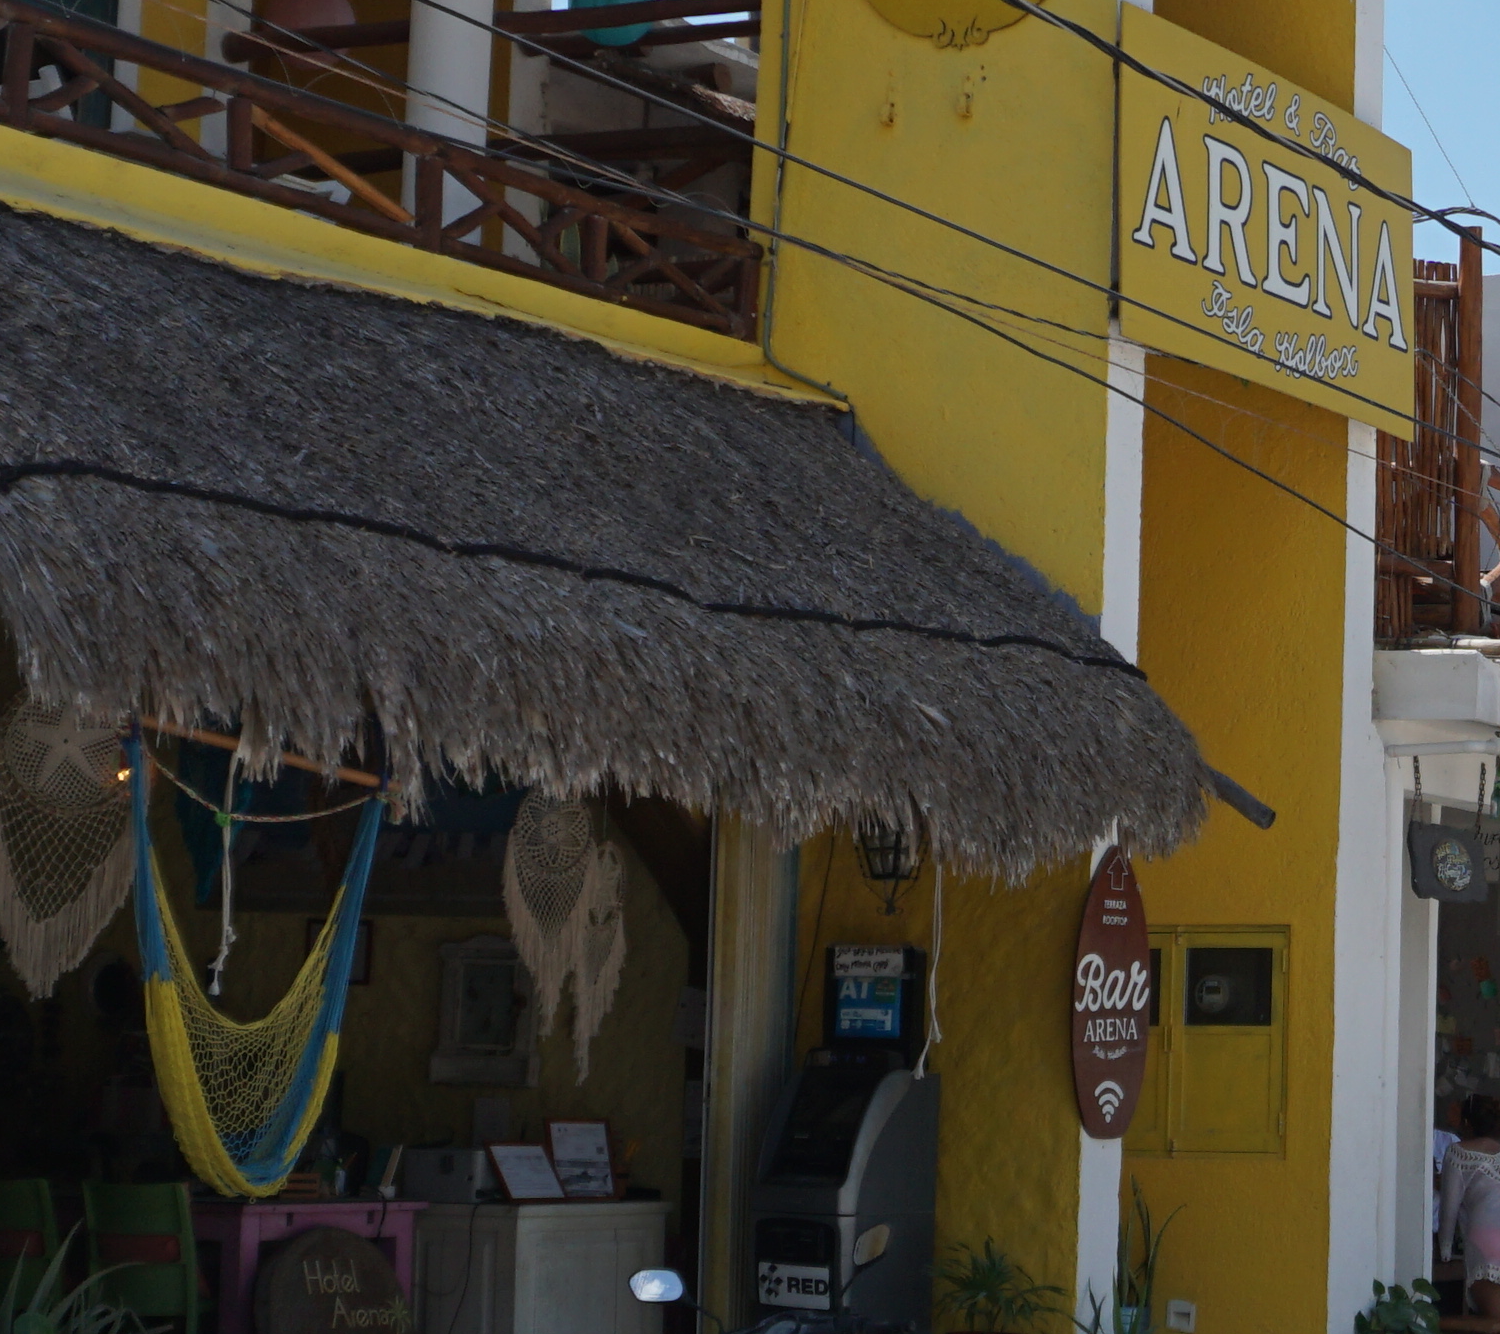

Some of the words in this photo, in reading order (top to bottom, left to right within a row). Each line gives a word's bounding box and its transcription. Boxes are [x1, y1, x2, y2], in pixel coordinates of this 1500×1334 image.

[1201, 73, 1277, 125] Hotel
[1284, 93, 1301, 137] &
[1309, 111, 1363, 191] Bar
[1131, 115, 1409, 353] ARENA
[1201, 280, 1267, 357] Isla
[1274, 330, 1360, 379] Holbox
[1074, 953, 1149, 1013] Bar
[1083, 1018, 1138, 1043] ARENA
[303, 1259, 360, 1295] Hotel
[787, 1276, 828, 1295] RED
[332, 1296, 390, 1329] Arena
